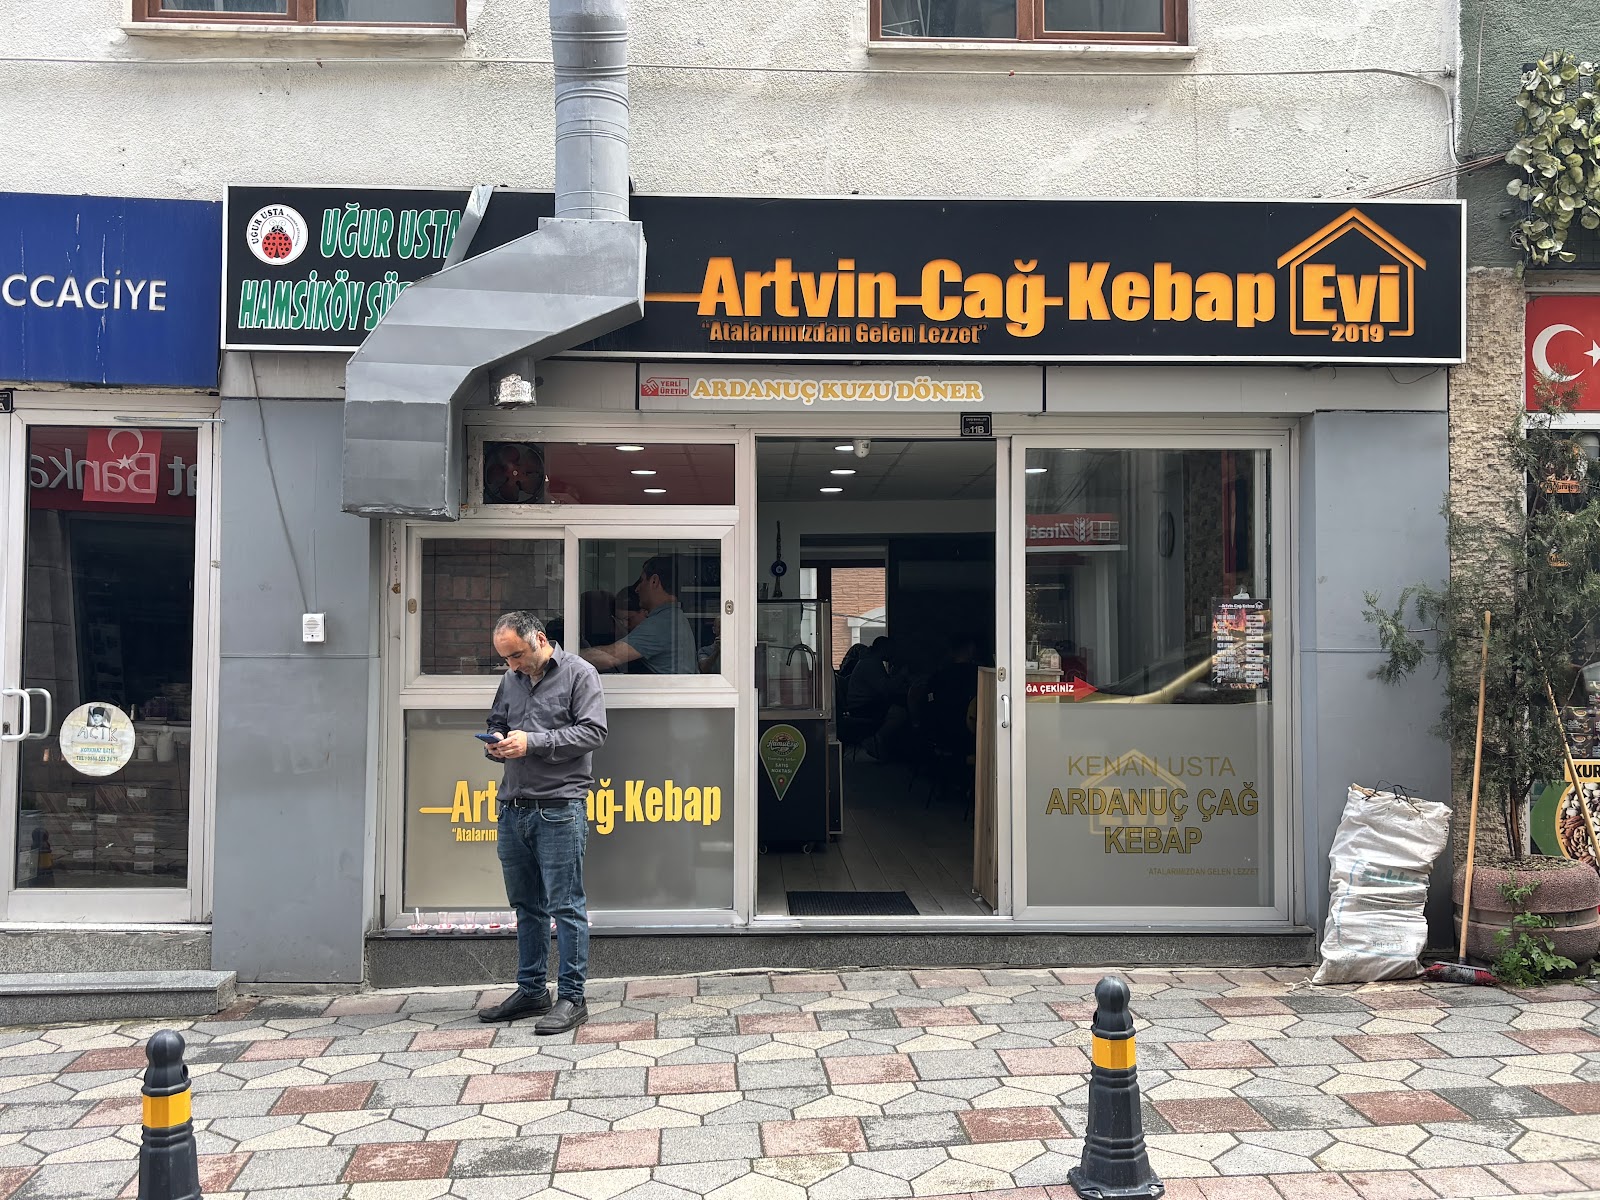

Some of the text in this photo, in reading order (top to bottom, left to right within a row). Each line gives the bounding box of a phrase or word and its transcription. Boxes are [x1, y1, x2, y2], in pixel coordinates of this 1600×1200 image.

[260, 208, 284, 219] USTA
[320, 202, 395, 258] UĞUR
[1, 269, 167, 311] CCACİYE
[238, 269, 414, 331] HAMSİKÖY SÜ
[697, 256, 1400, 337] Artvin Cağ Kebap Evi
[855, 322, 915, 344] Gelen
[919, 323, 988, 344] Lezzet”
[1331, 323, 1385, 343] 2019
[660, 387, 687, 395] ÜRETİM
[692, 375, 984, 404] ARDANUÇ KUZU DÖNER
[969, 425, 985, 434] 11B
[1026, 683, 1075, 695] ĞA ÇEKİNİZ
[1068, 755, 1236, 777] KENAN USTA
[451, 780, 499, 823] Art
[625, 779, 721, 826] Kebap
[1045, 781, 1259, 823] ARDANUÇ ÇAĞ
[452, 827, 498, 842] “Atalarım
[1104, 826, 1203, 854] KEBAP
[1207, 867, 1231, 876] GELEN
